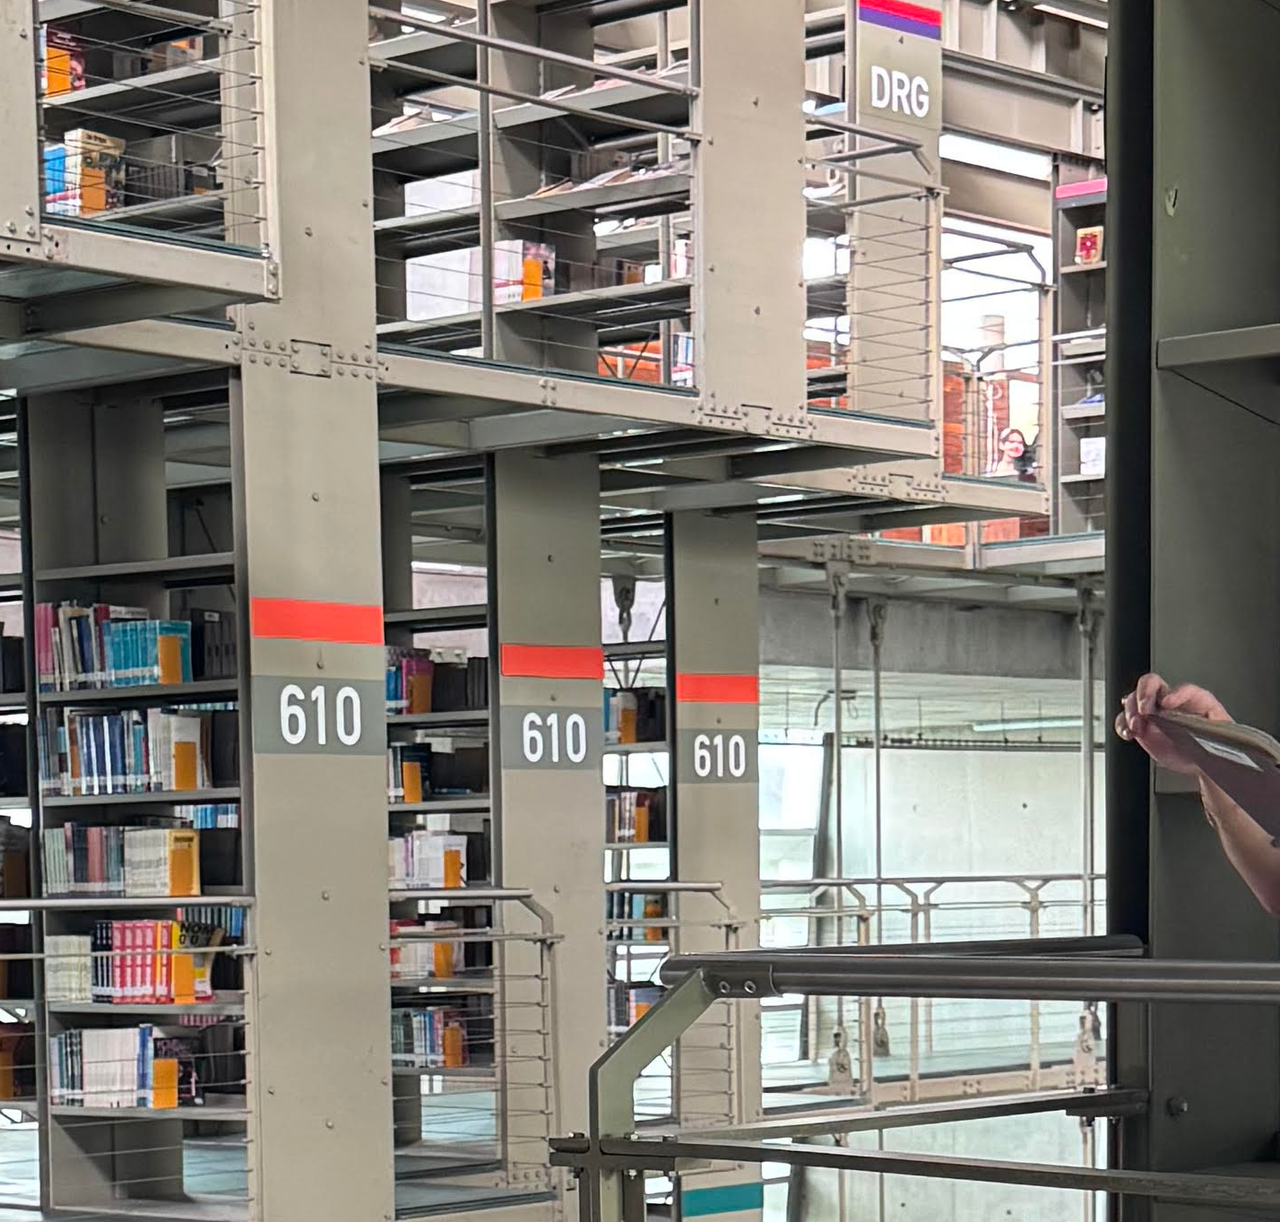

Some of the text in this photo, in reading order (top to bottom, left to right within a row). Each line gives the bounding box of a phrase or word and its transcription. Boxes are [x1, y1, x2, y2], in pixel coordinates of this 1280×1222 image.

[871, 65, 929, 117] DRG
[280, 684, 362, 746] 610
[523, 712, 586, 764] 610
[693, 734, 746, 777] 610
